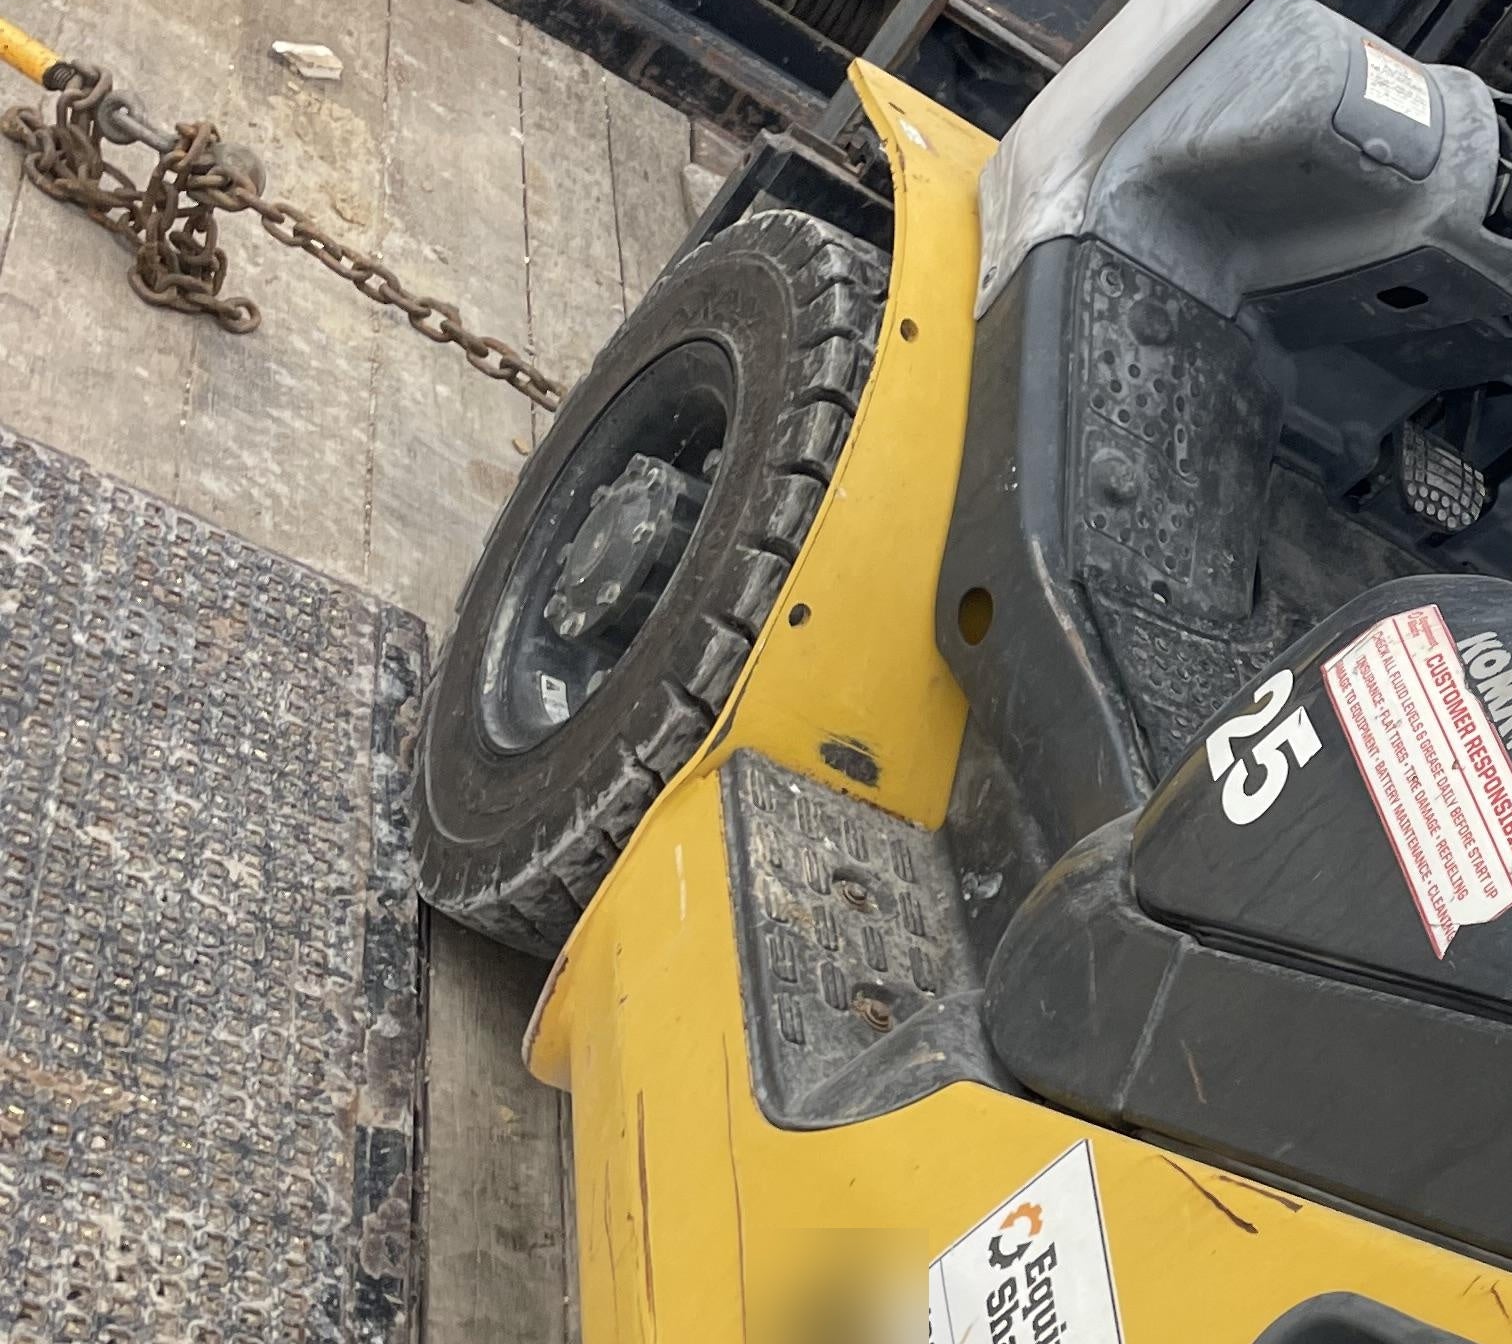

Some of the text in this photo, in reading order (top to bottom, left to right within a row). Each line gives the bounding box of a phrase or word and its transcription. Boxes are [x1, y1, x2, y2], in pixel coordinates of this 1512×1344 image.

[1381, 654, 1398, 674] ALL
[1388, 670, 1409, 700] FLUID
[1343, 688, 1357, 705] TO
[1400, 696, 1424, 732] LEVELS
[1424, 651, 1477, 740] CUSTOMER
[1206, 669, 1323, 825] 25
[1348, 701, 1380, 758] EQUIPMENT
[1354, 654, 1469, 901] INSURANCE FLAT TIRES TIRE DAMAGE REFUELING
[1418, 737, 1444, 779] GREASE
[1373, 760, 1400, 806] BATTERY
[1435, 775, 1458, 809] DAILY
[1391, 803, 1433, 882] MAINTENANCE
[1449, 805, 1476, 850] BEFORE
[1466, 845, 1491, 885] START
[1482, 880, 1498, 901] UP
[1426, 883, 1458, 942] CLEANING
